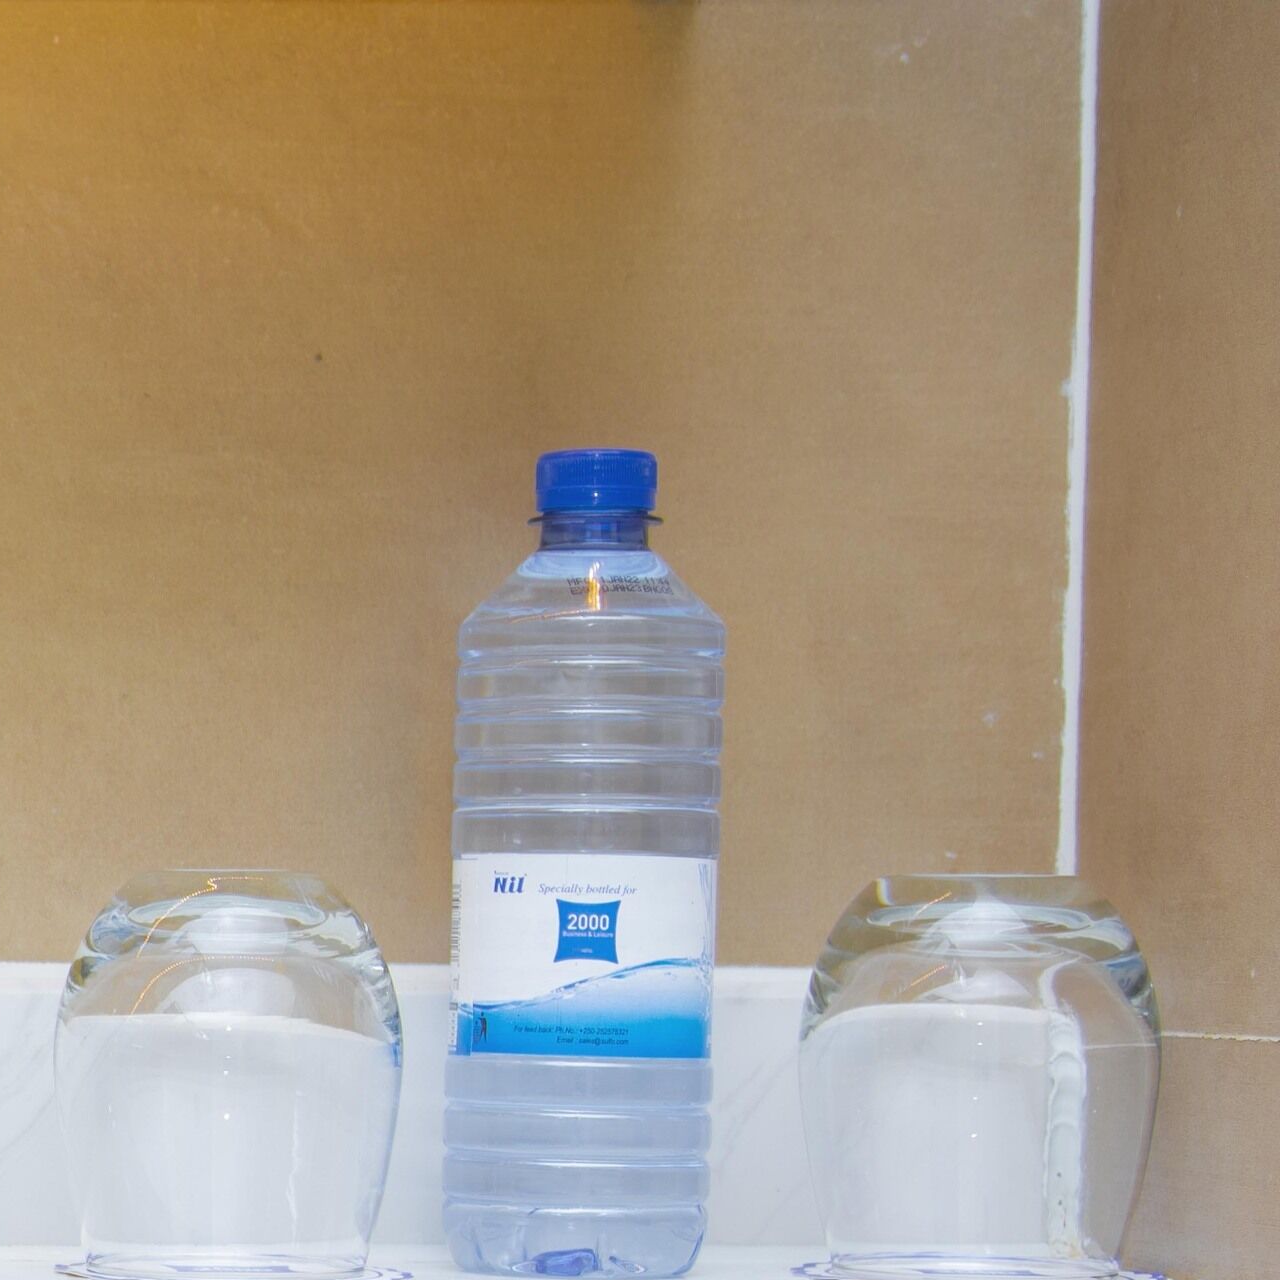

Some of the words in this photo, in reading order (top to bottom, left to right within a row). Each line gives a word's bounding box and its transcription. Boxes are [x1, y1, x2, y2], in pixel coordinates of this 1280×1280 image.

[493, 876, 525, 894] Nil
[538, 883, 583, 895] Specially
[586, 885, 620, 895] bottled
[622, 885, 638, 897] for
[567, 913, 610, 931] 2000
